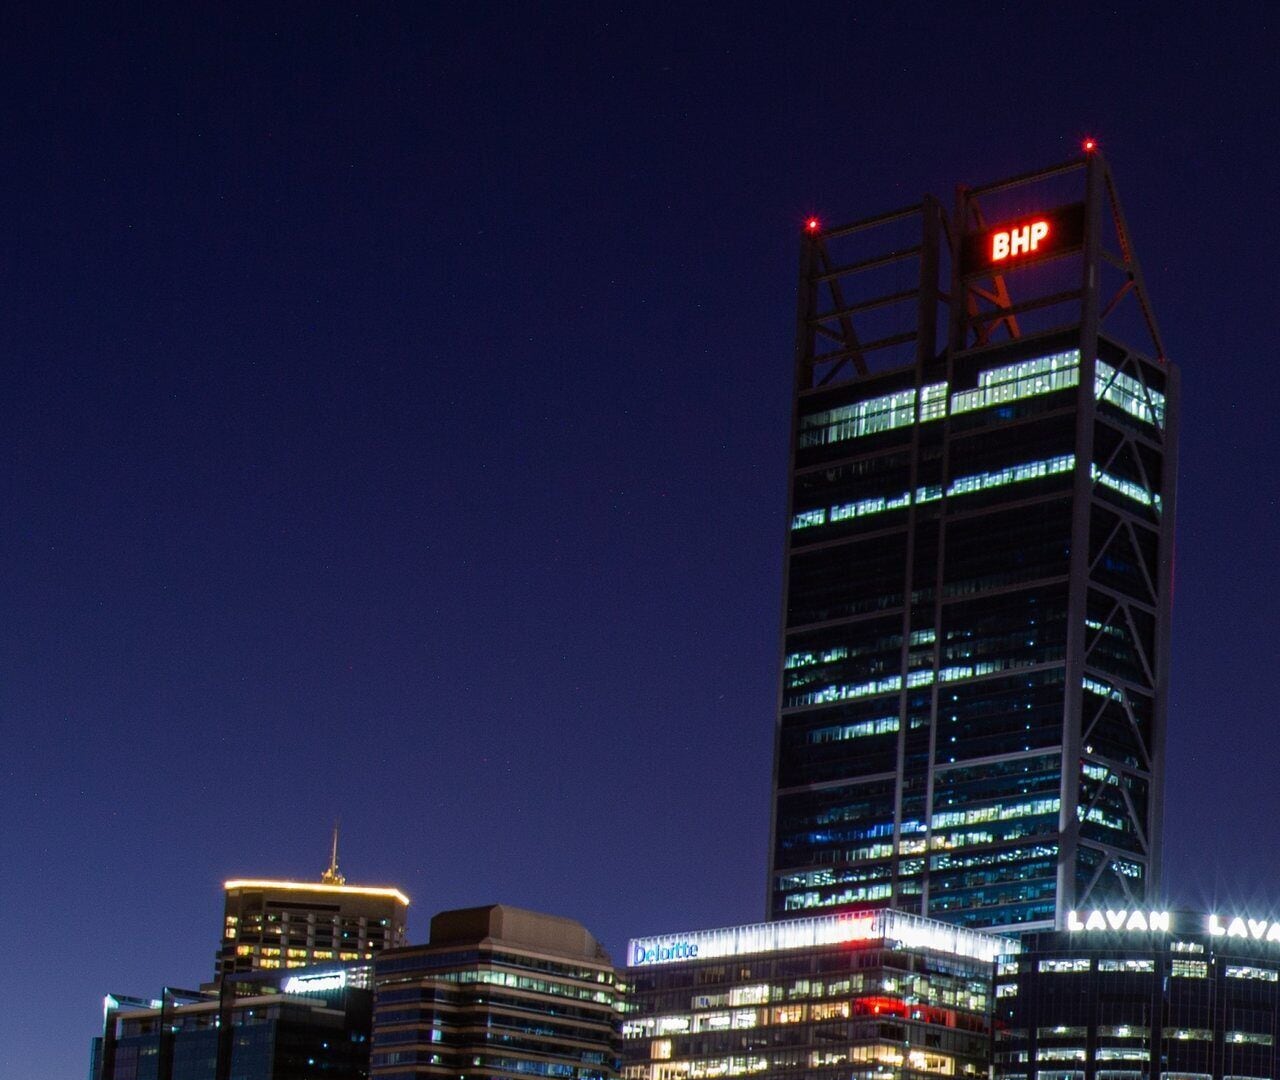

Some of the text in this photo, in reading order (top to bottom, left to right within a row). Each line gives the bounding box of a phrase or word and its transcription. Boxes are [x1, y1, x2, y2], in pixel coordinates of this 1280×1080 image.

[991, 220, 1050, 262] BHP
[1067, 910, 1170, 932] LAVAN
[633, 940, 699, 965] Deloitte
